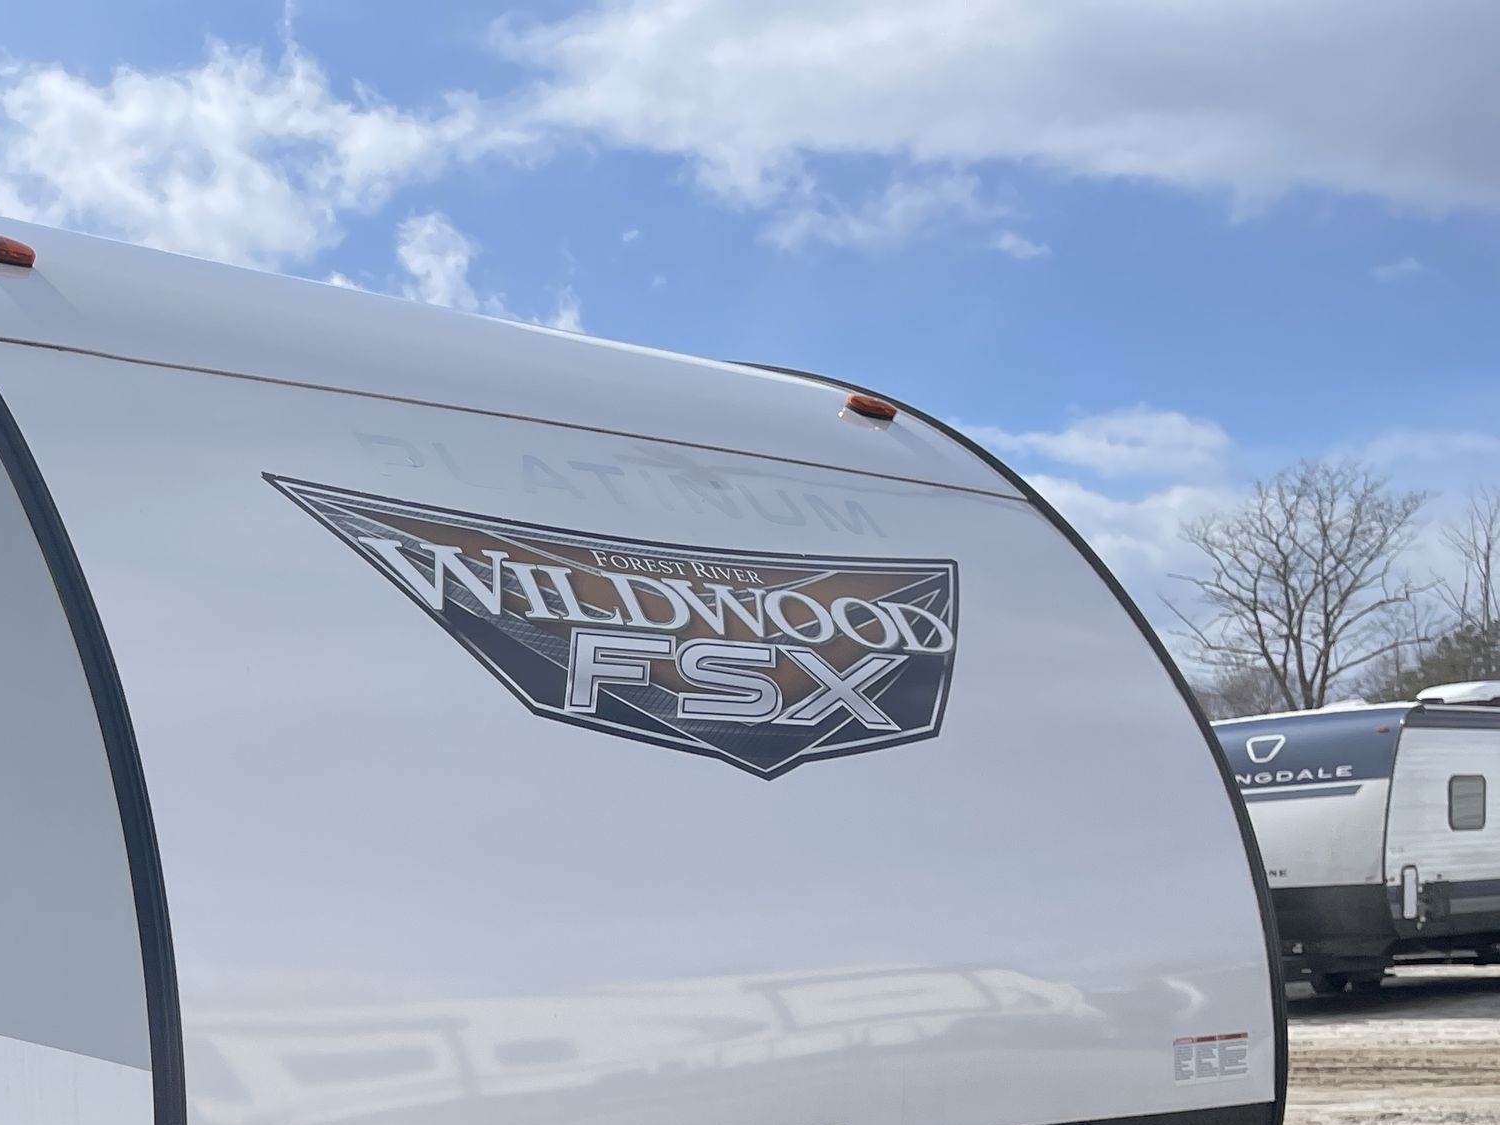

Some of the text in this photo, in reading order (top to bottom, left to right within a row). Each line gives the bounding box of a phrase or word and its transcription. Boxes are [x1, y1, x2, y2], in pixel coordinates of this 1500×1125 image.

[358, 536, 955, 654] WILDWOOD
[590, 550, 764, 585] FOREST RIVER
[564, 626, 902, 731] FSX
[1235, 765, 1353, 785] NGDALE
